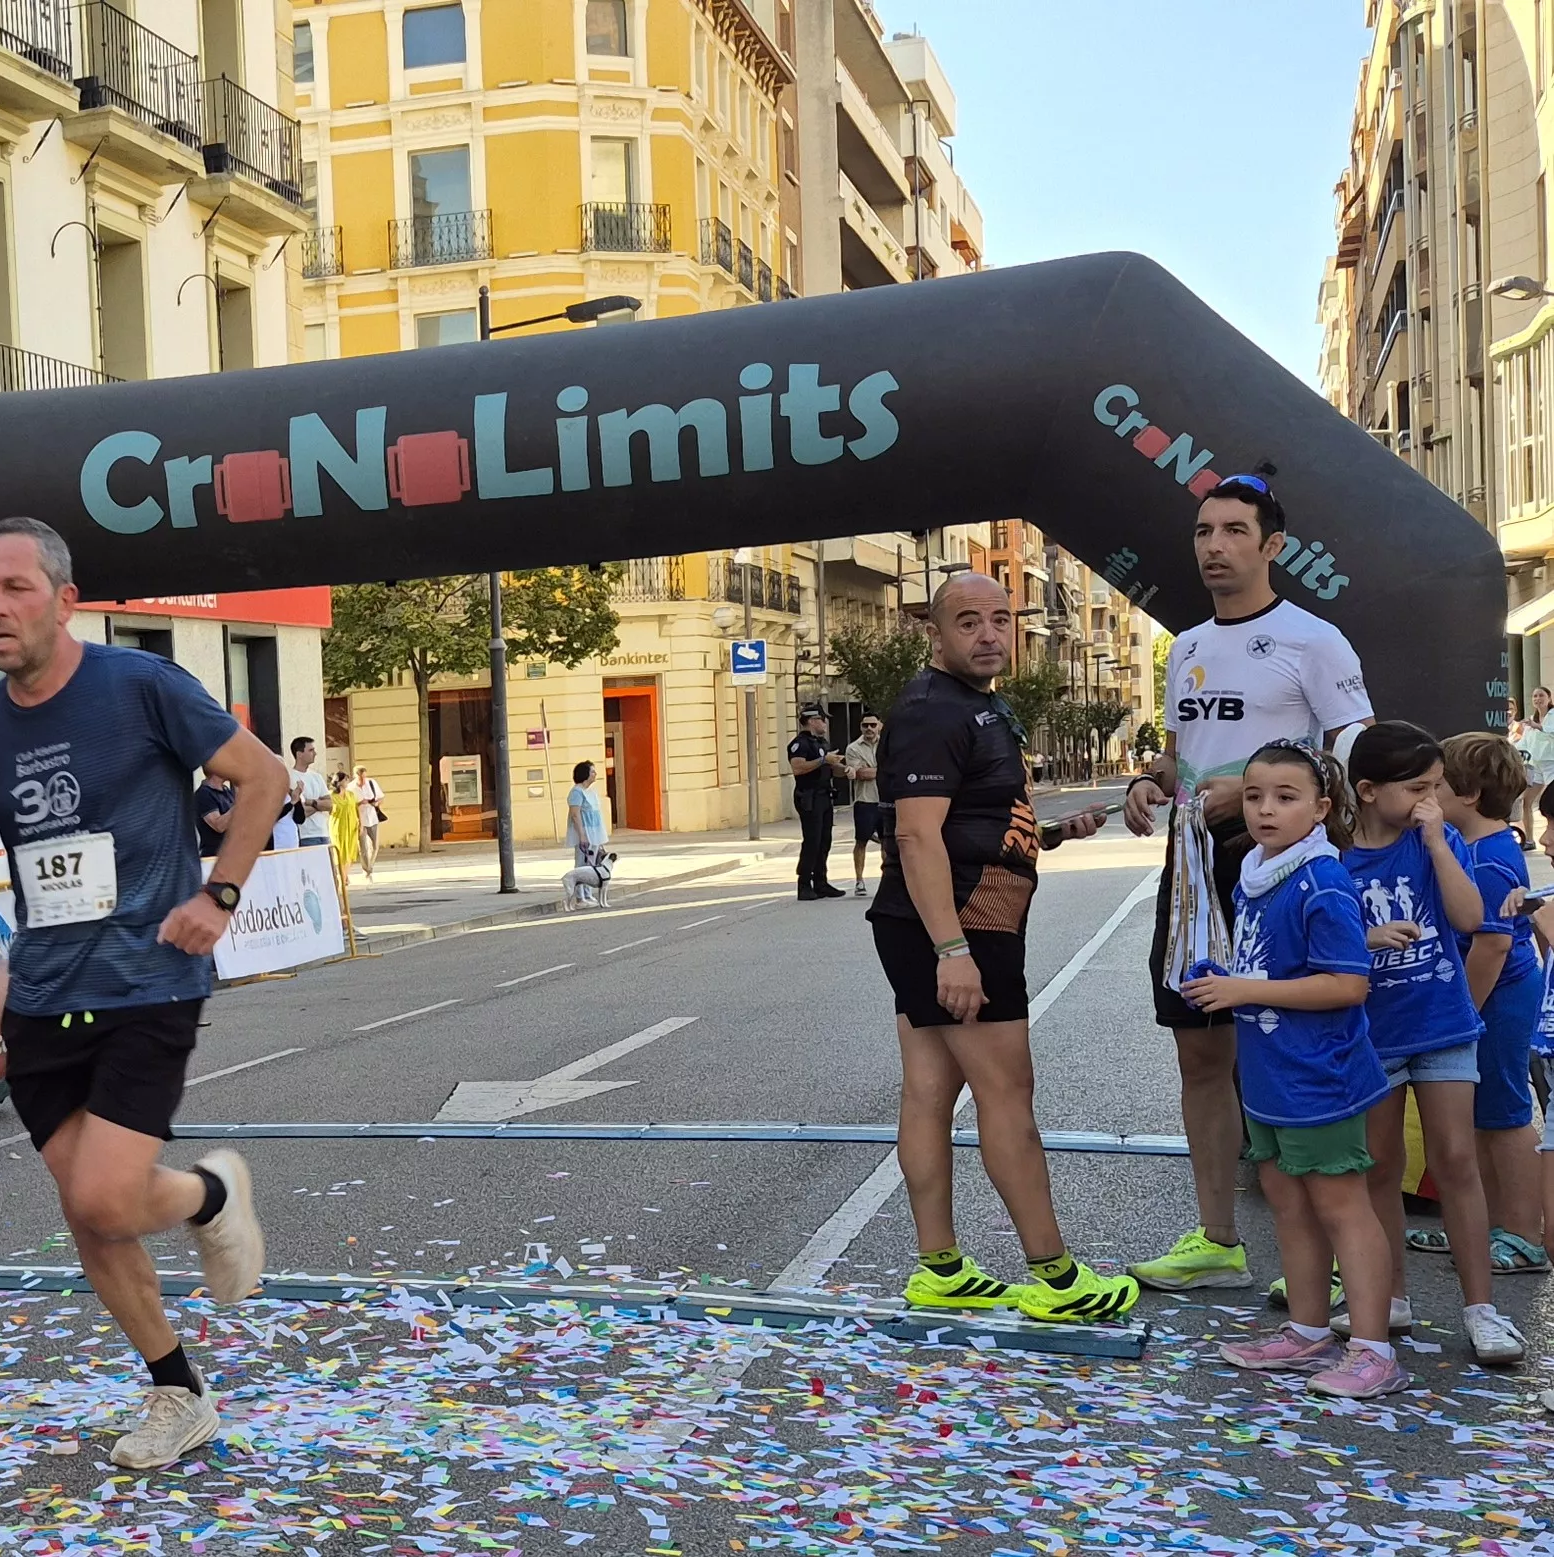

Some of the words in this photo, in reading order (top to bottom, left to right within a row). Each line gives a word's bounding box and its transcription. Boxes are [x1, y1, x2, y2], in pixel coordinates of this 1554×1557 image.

[1178, 697, 1245, 722] SYB
[35, 852, 83, 880] 187
[229, 896, 304, 952] podoactiva
